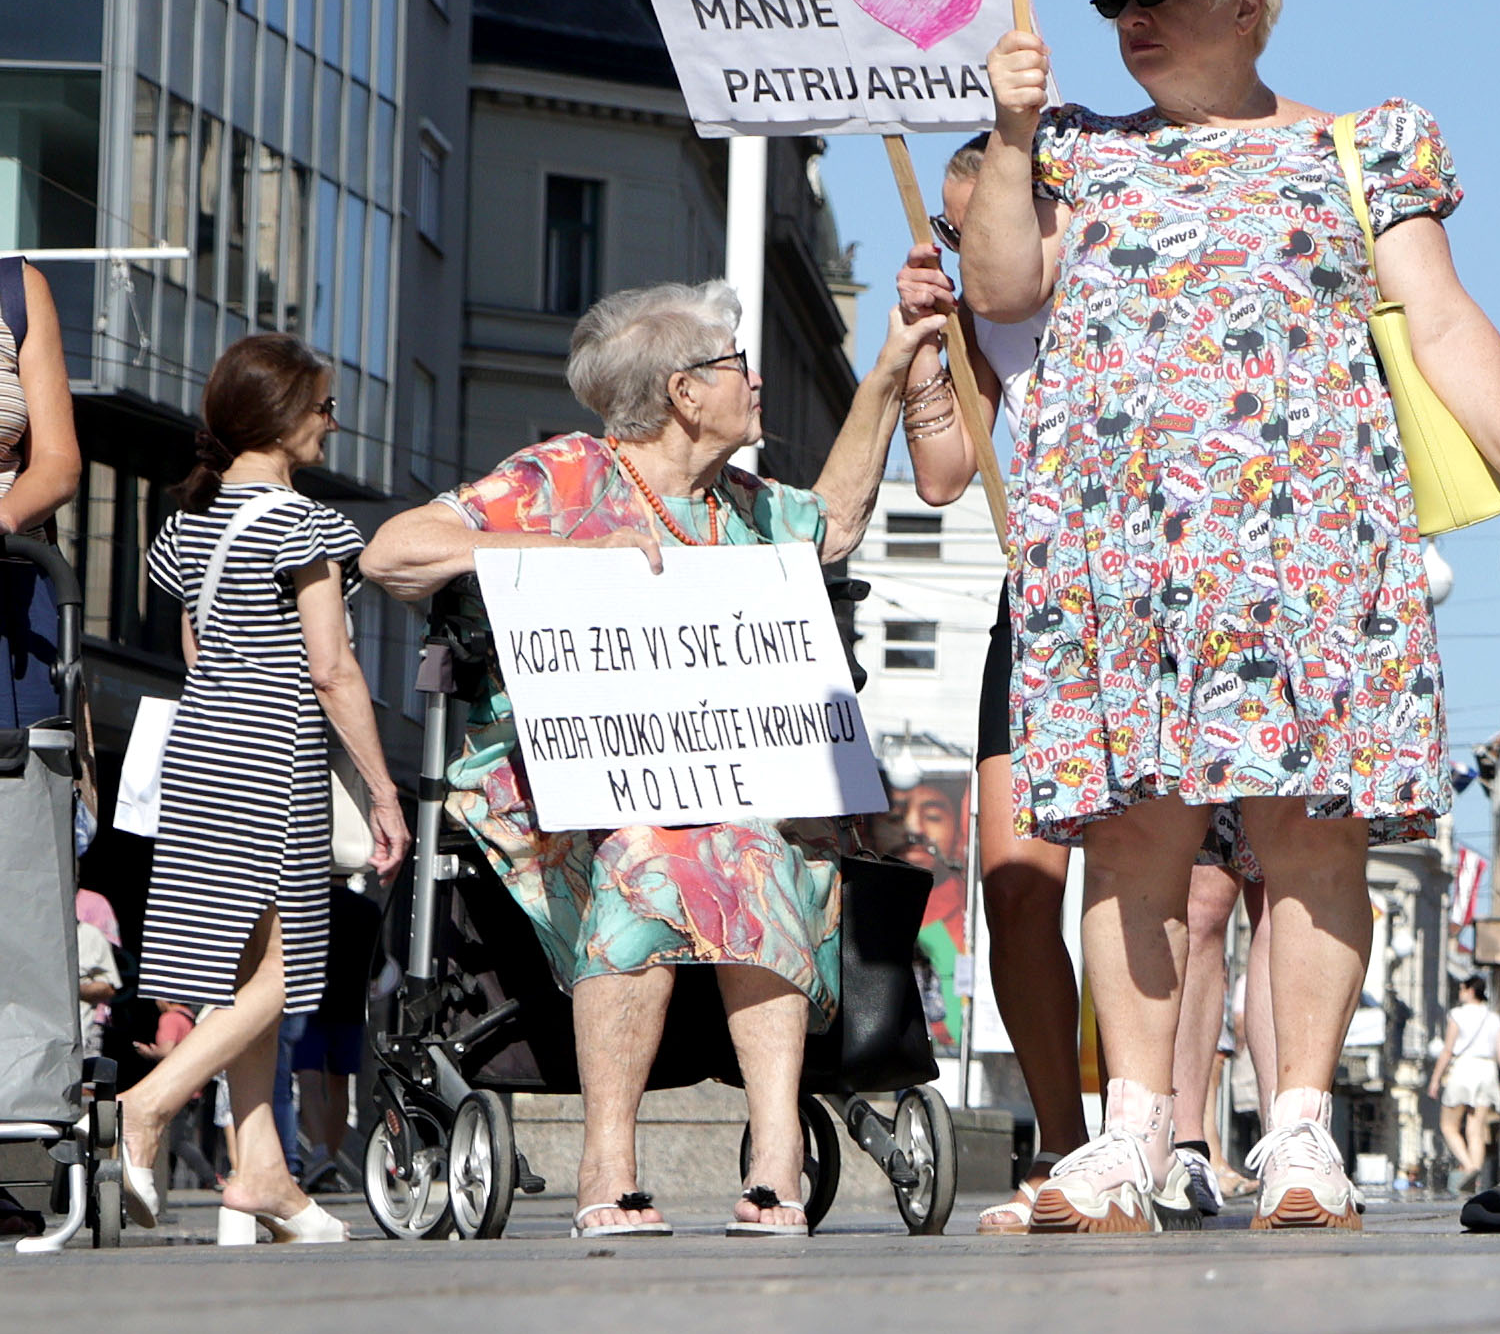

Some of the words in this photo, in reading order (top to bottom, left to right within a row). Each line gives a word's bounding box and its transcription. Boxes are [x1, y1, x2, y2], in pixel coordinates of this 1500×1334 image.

[510, 628, 580, 674] KOJA
[590, 626, 636, 672] ZLA
[642, 626, 671, 670] VI
[678, 623, 728, 669] SVE
[732, 610, 816, 666] ČINITE
[1203, 677, 1239, 704] BANG!
[525, 716, 593, 761] KADA
[590, 712, 665, 758] TOLIKO
[668, 699, 747, 754] KLEČITE
[748, 707, 758, 748] I
[760, 699, 856, 749] KRUNICU
[607, 763, 753, 813] MOLITE
